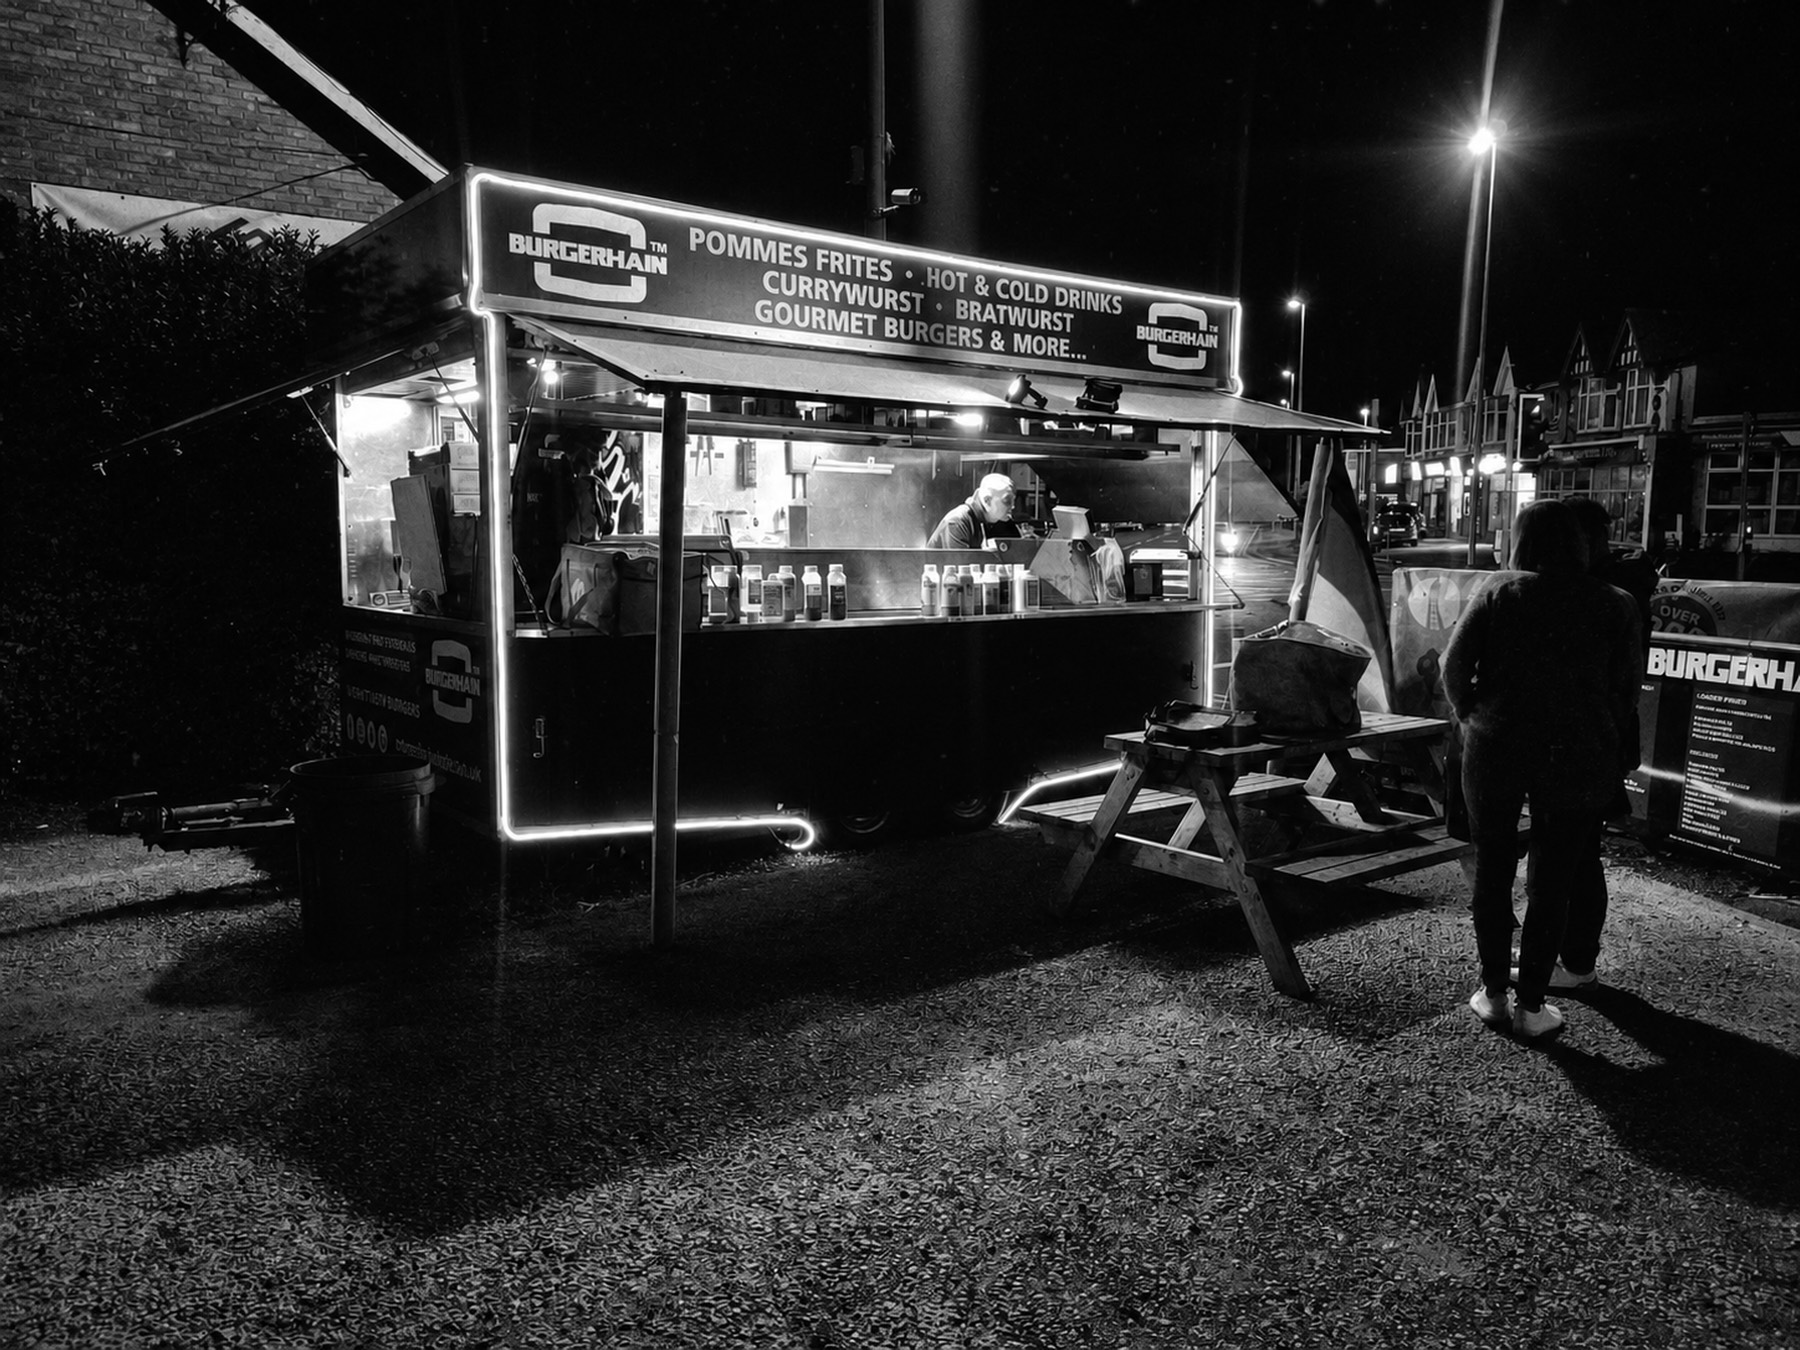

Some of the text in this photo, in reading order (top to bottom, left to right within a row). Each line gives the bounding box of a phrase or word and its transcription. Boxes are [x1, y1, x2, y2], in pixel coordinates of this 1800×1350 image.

[508, 232, 668, 275] BURGERHAIN
[649, 241, 668, 254] TM
[689, 226, 1123, 316] POMMES FRITES HOT & COLD DRINKS
[762, 270, 1074, 334] CURRYWURST BRATWURST
[754, 299, 1088, 361] GOURMET BURGERS & MORE...
[1136, 325, 1219, 349] BURGERHAIN
[1659, 604, 1702, 626] OVER
[424, 667, 481, 697] BURGERHAIN
